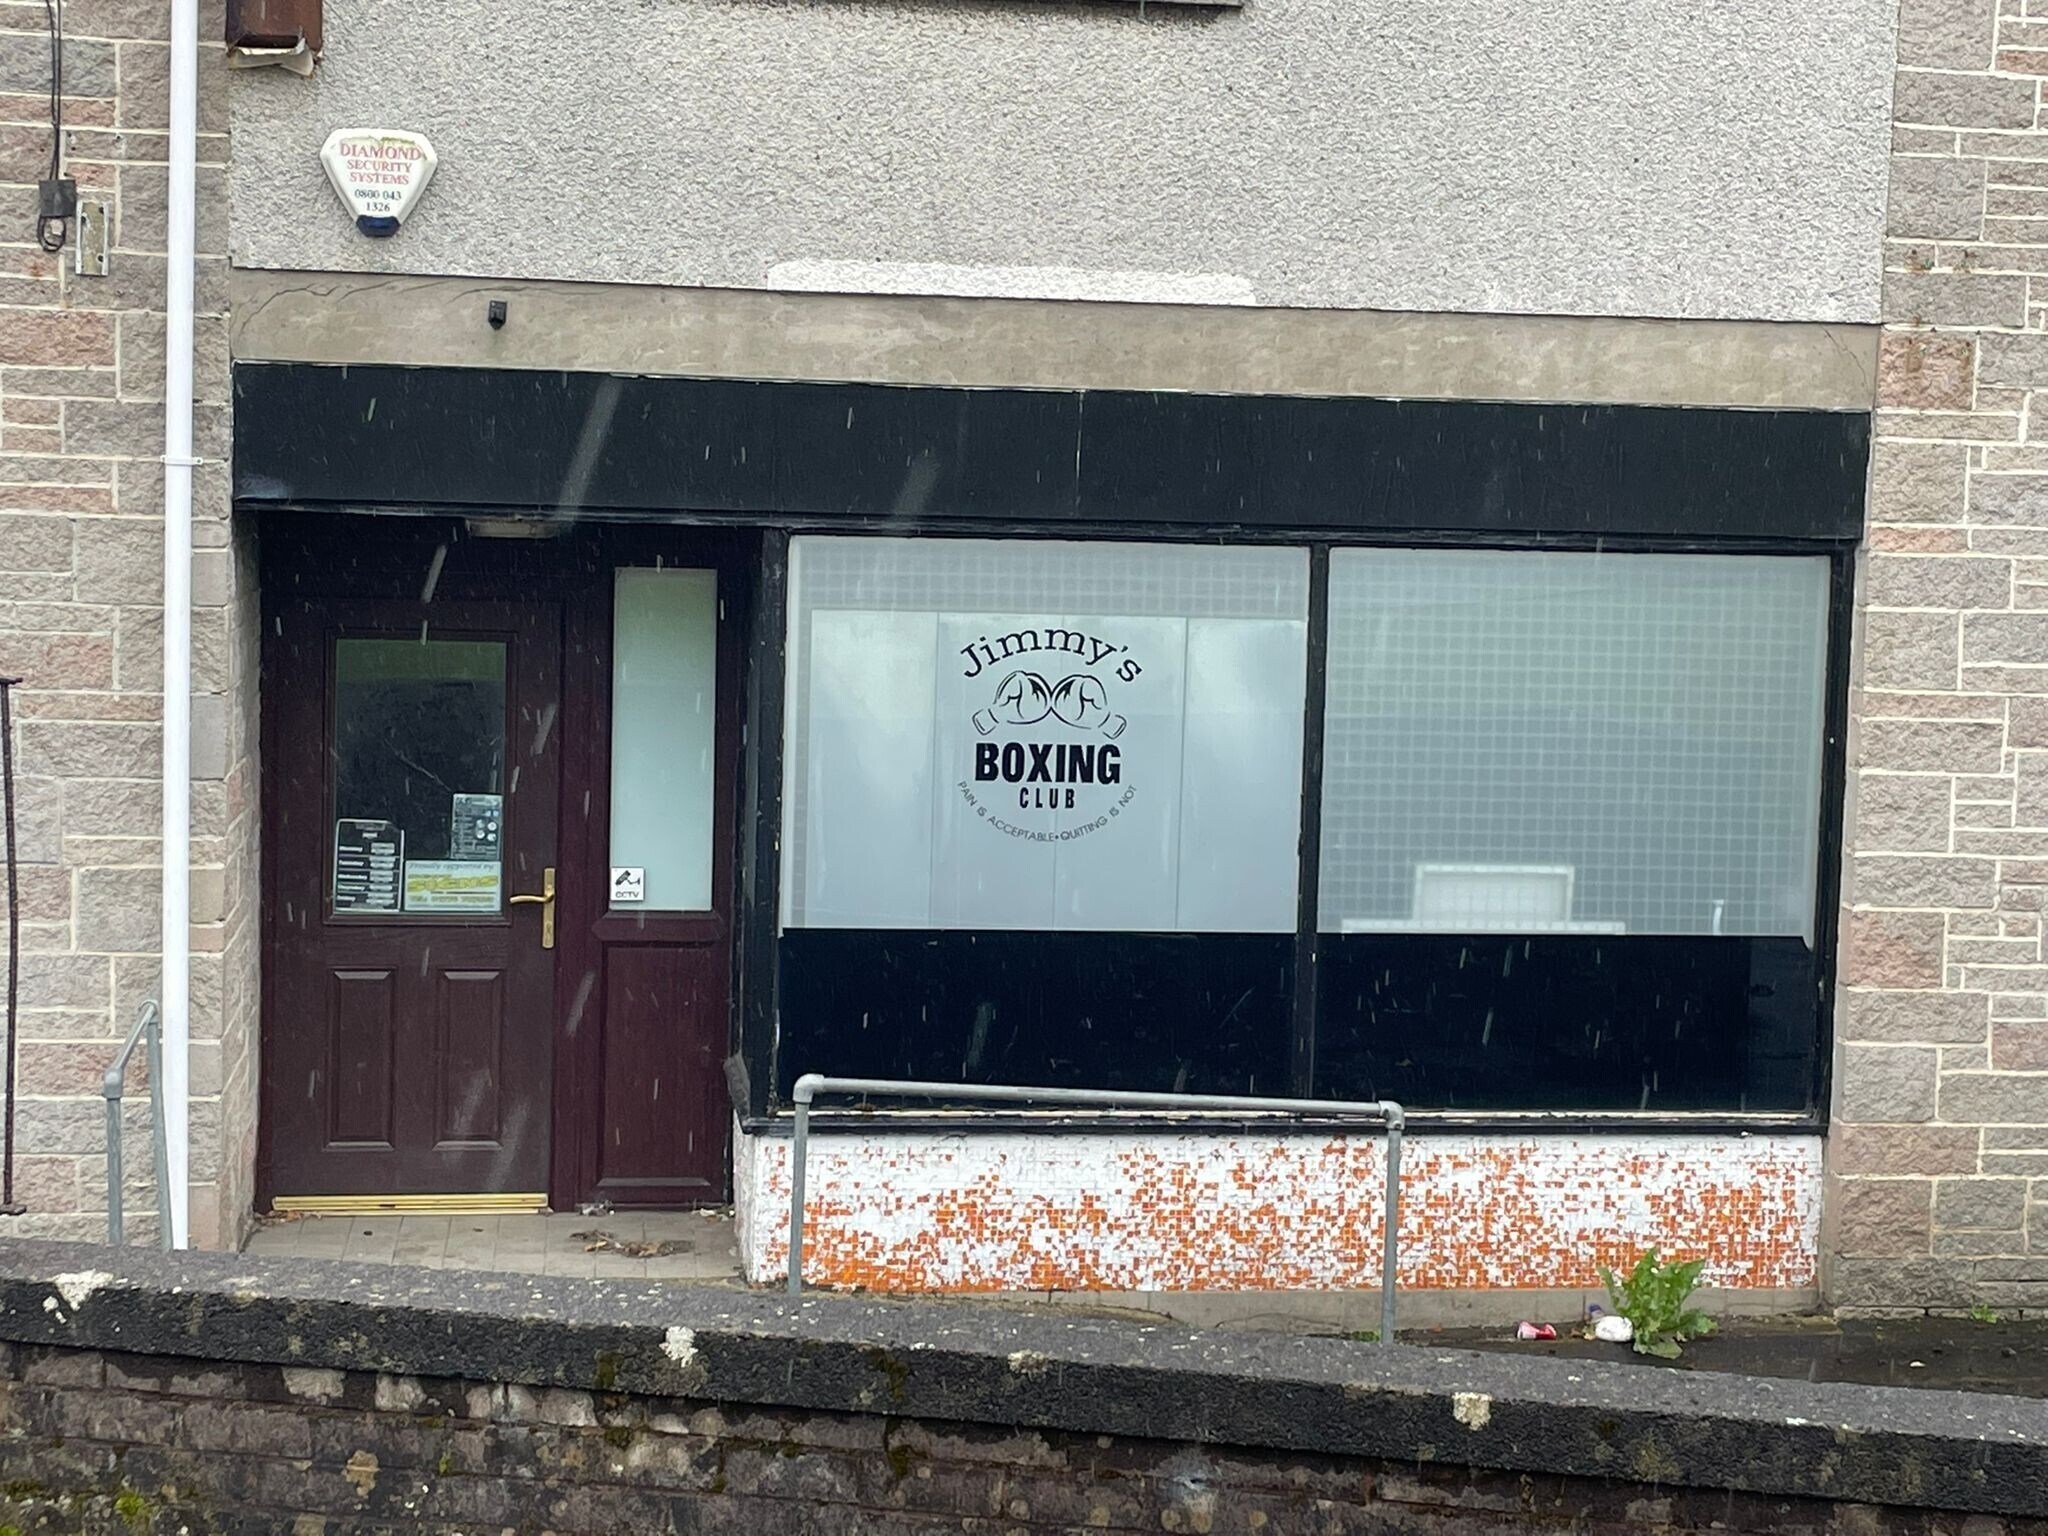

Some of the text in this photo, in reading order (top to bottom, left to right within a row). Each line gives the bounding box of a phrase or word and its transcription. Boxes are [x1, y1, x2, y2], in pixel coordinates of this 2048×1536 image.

[340, 143, 421, 160] DIAMOND
[347, 159, 412, 173] SECURITY
[350, 172, 409, 185] SYSTEMS
[354, 189, 402, 200] 0800 043
[366, 202, 390, 212] 1326
[960, 629, 1142, 683] Jimmy's
[975, 742, 1121, 785] BOXING
[957, 781, 978, 806] PAIN
[976, 806, 988, 817] IS
[1109, 806, 1120, 817] IS
[1118, 784, 1137, 808] NOT
[1019, 787, 1075, 809] CLUB
